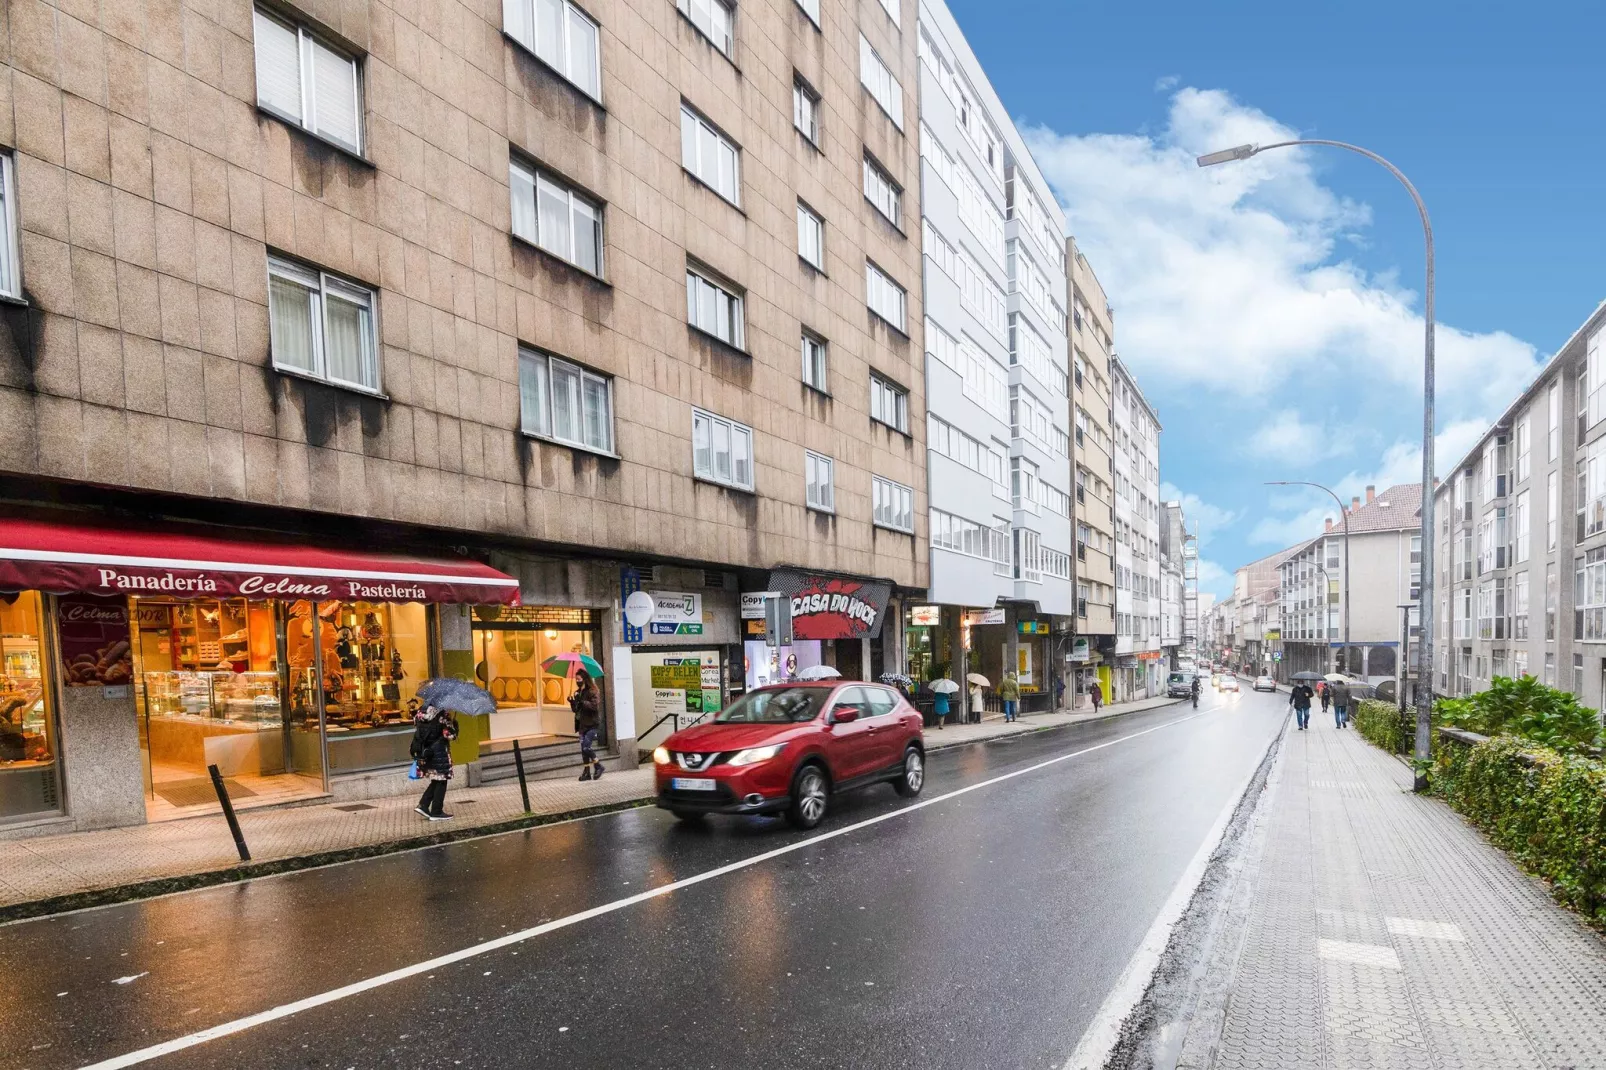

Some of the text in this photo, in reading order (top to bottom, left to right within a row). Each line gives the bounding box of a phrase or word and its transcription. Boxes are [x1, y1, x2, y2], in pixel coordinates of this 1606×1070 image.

[98, 569, 426, 599] Panadería Celma Pastelería
[67, 606, 121, 620] Celma
[791, 593, 830, 617] CASA
[830, 594, 850, 613] DO
